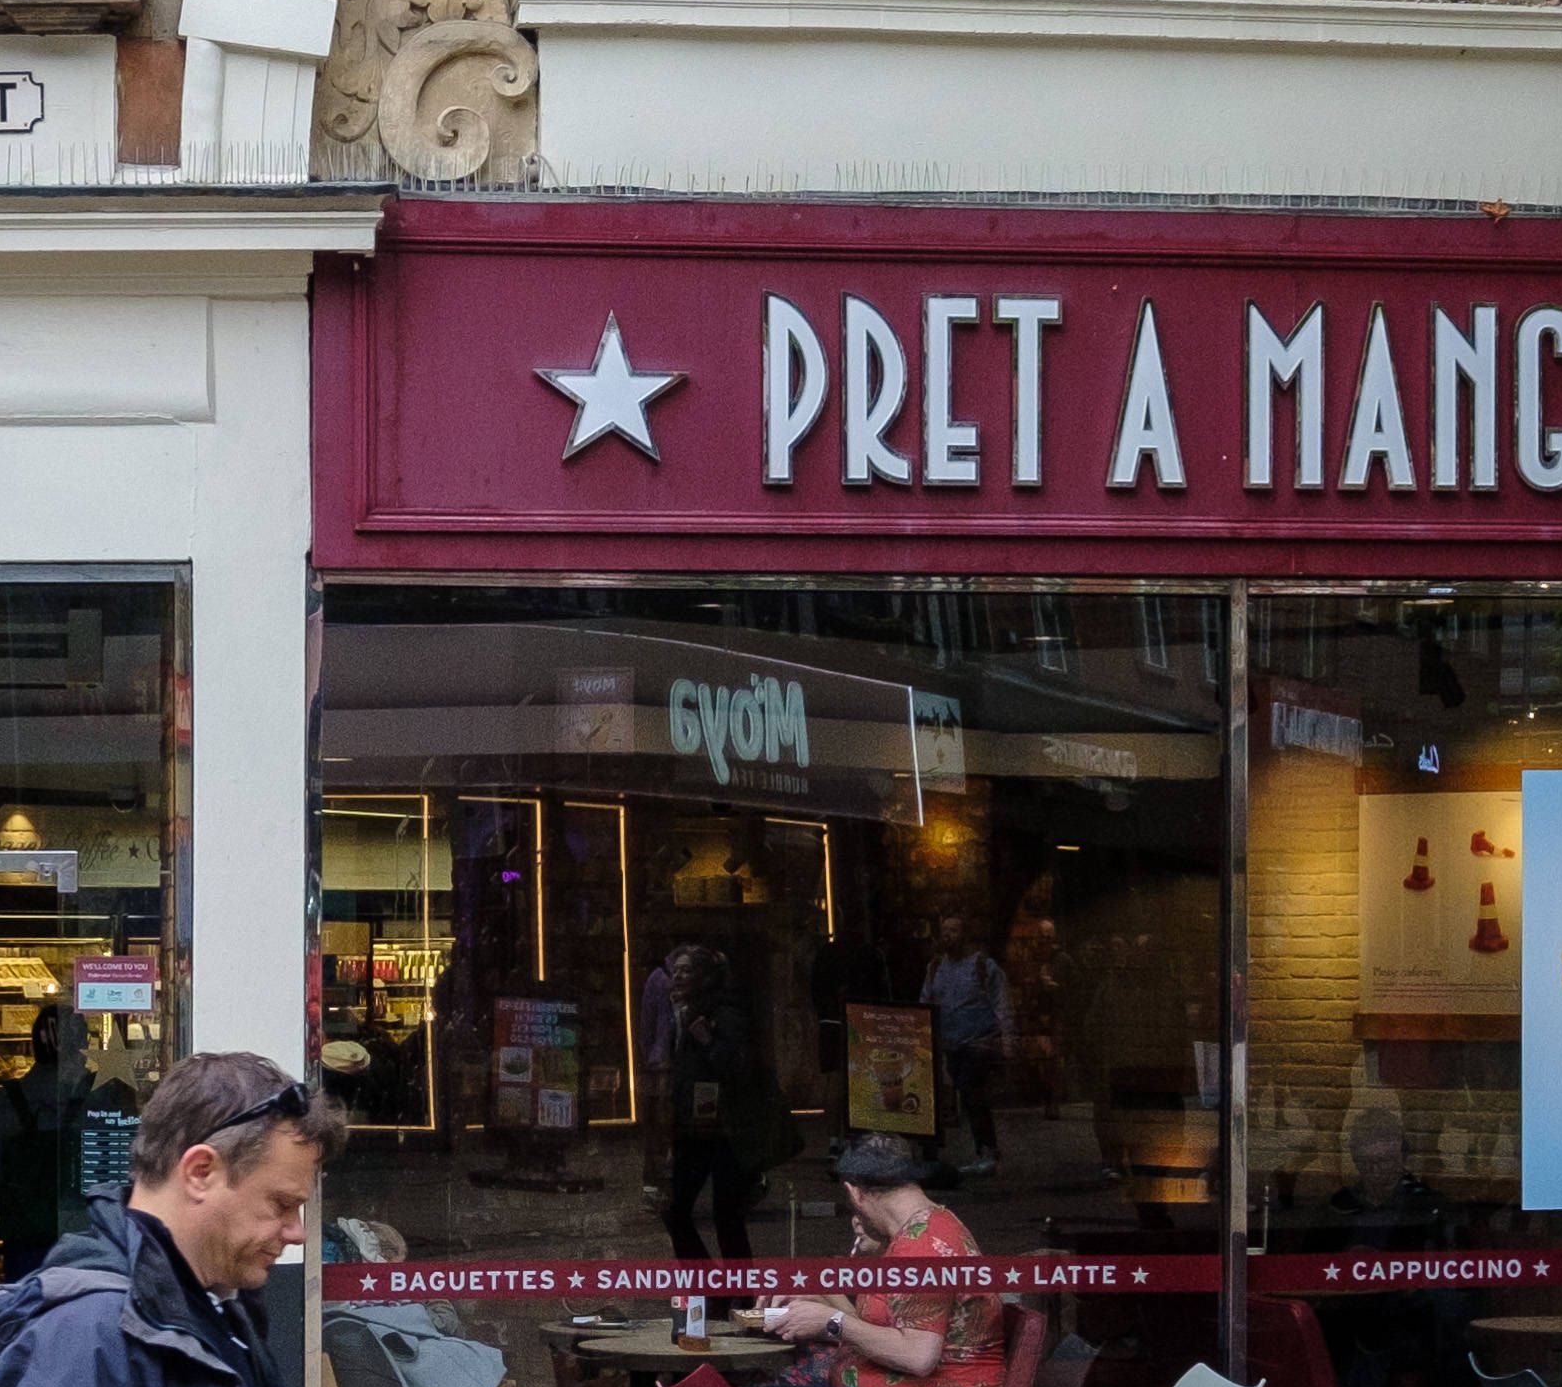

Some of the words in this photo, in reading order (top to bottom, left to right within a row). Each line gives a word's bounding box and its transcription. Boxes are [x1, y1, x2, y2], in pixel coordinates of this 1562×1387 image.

[761, 290, 1062, 488] PRET
[1105, 296, 1187, 489] A
[390, 1269, 555, 1292] BAGUETTES
[597, 1268, 779, 1291] SANDWICHES
[819, 1266, 992, 1289] CROISSANTS
[1034, 1265, 1116, 1285] LATTE
[1352, 1258, 1522, 1281] CAPPUCCINO
